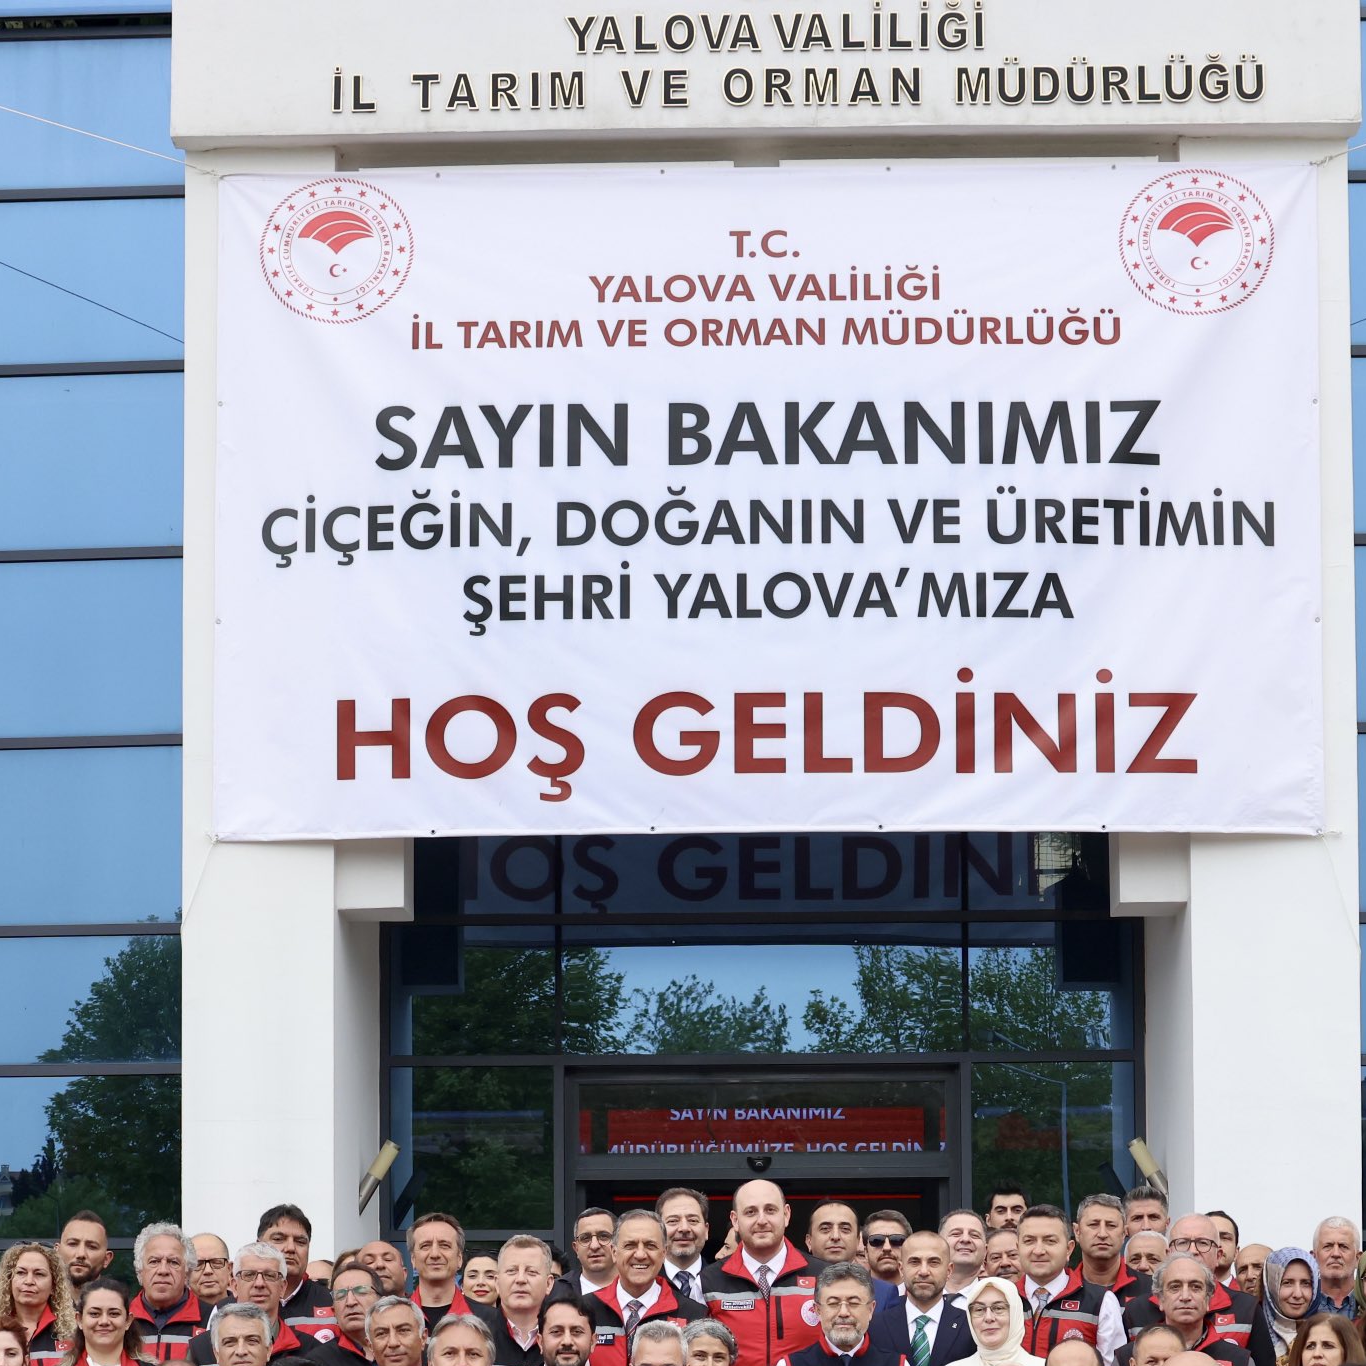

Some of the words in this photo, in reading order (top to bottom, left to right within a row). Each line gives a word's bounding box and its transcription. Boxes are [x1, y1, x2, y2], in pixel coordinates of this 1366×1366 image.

[565, 13, 761, 54] YALOVA
[771, 0, 985, 52] VALİLİĞİ
[332, 66, 376, 112] İL
[411, 70, 585, 111] TARIM
[620, 69, 689, 107] VE
[722, 66, 921, 106] ORMAN
[956, 52, 1265, 106] MÜDÜRLÜĞÜ
[324, 199, 356, 208] TARIM
[359, 204, 371, 215] VE
[371, 213, 390, 247] ORMAN
[1182, 190, 1214, 199] TARIM
[1217, 196, 1229, 207] VE
[1230, 205, 1251, 238] ORMAN
[729, 229, 800, 259] T.C.
[589, 274, 756, 303] YALOVA
[767, 264, 941, 302] VALİLİĞİ
[411, 313, 443, 350] İL
[456, 319, 583, 349] TARIM
[596, 319, 647, 348] VE
[663, 317, 826, 348] ORMAN
[841, 307, 1122, 346] MÜDÜRLÜĞÜ
[374, 403, 629, 472] SAYIN
[668, 399, 1162, 466] BAKANIMIZ
[261, 488, 532, 568] ÇİÇEĞİN,
[556, 485, 865, 548] DOĞANIN
[886, 498, 961, 546] VE
[986, 485, 1275, 547] ÜRETİMİN
[462, 561, 631, 637] ŞEHRİ
[336, 692, 586, 803] HOŞ
[632, 667, 1198, 777] GELDİNİZ
